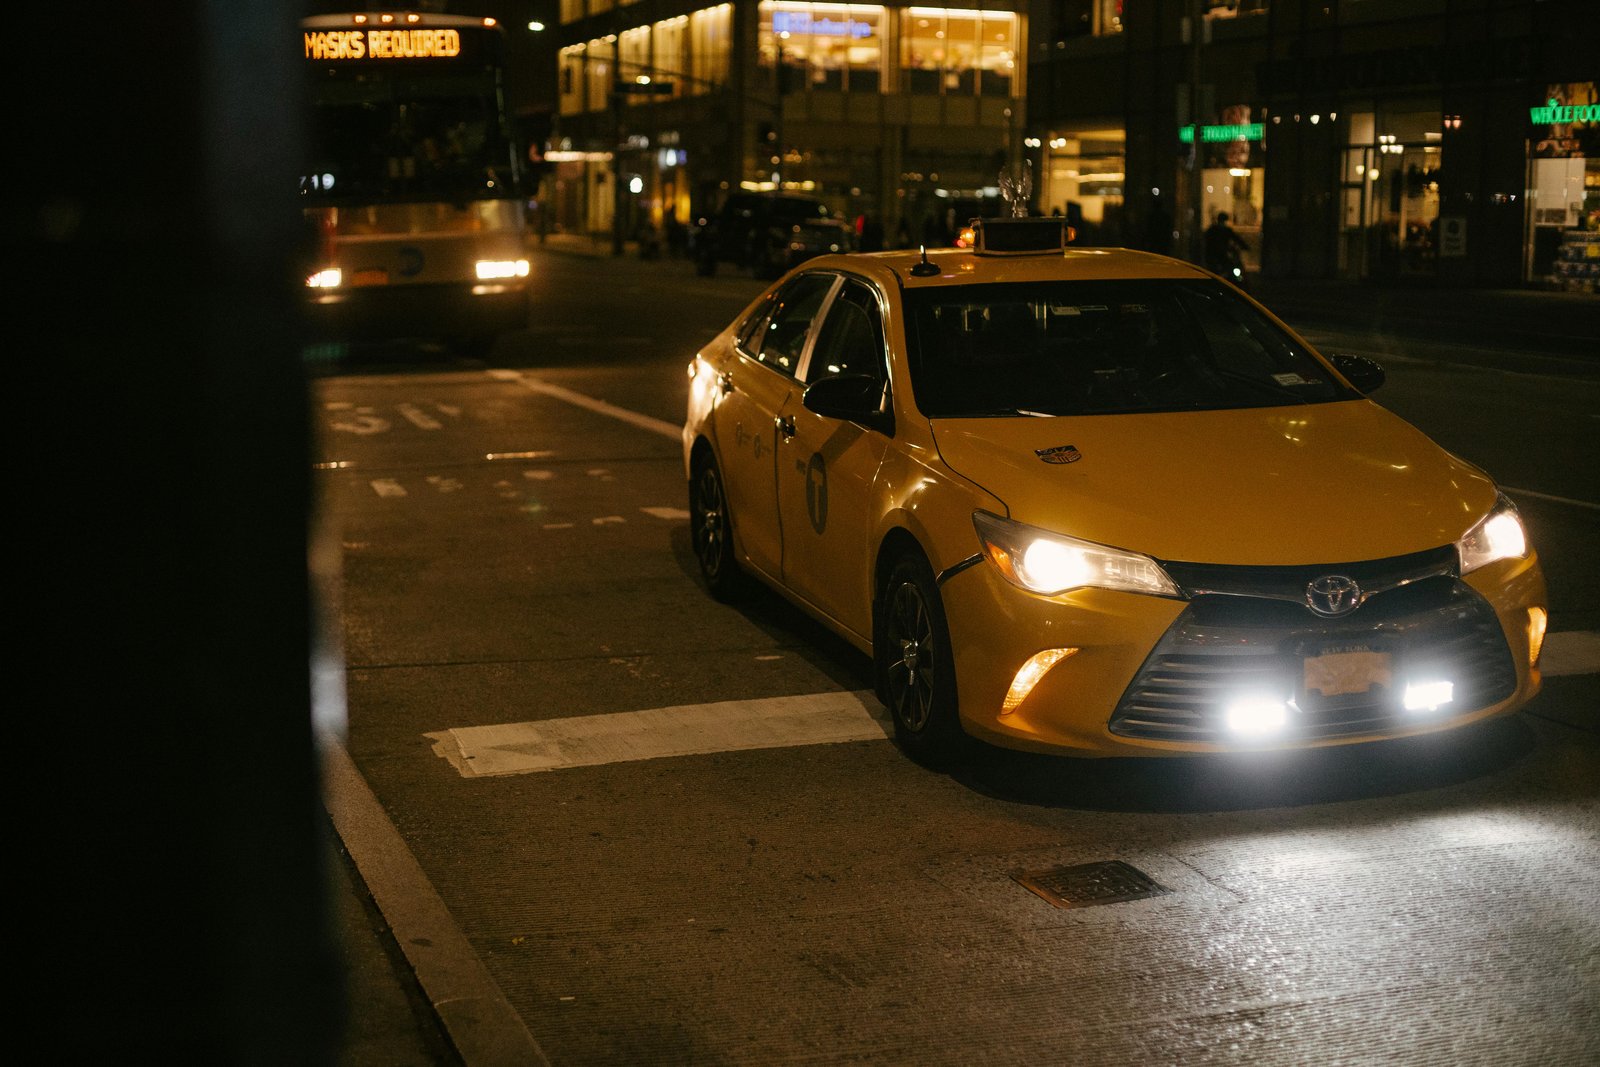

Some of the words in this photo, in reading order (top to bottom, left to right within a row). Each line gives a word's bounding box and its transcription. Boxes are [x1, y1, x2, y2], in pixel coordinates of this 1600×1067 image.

[304, 31, 366, 59] MASKS
[368, 29, 461, 58] REQUIRED
[1573, 104, 1600, 123] FOO
